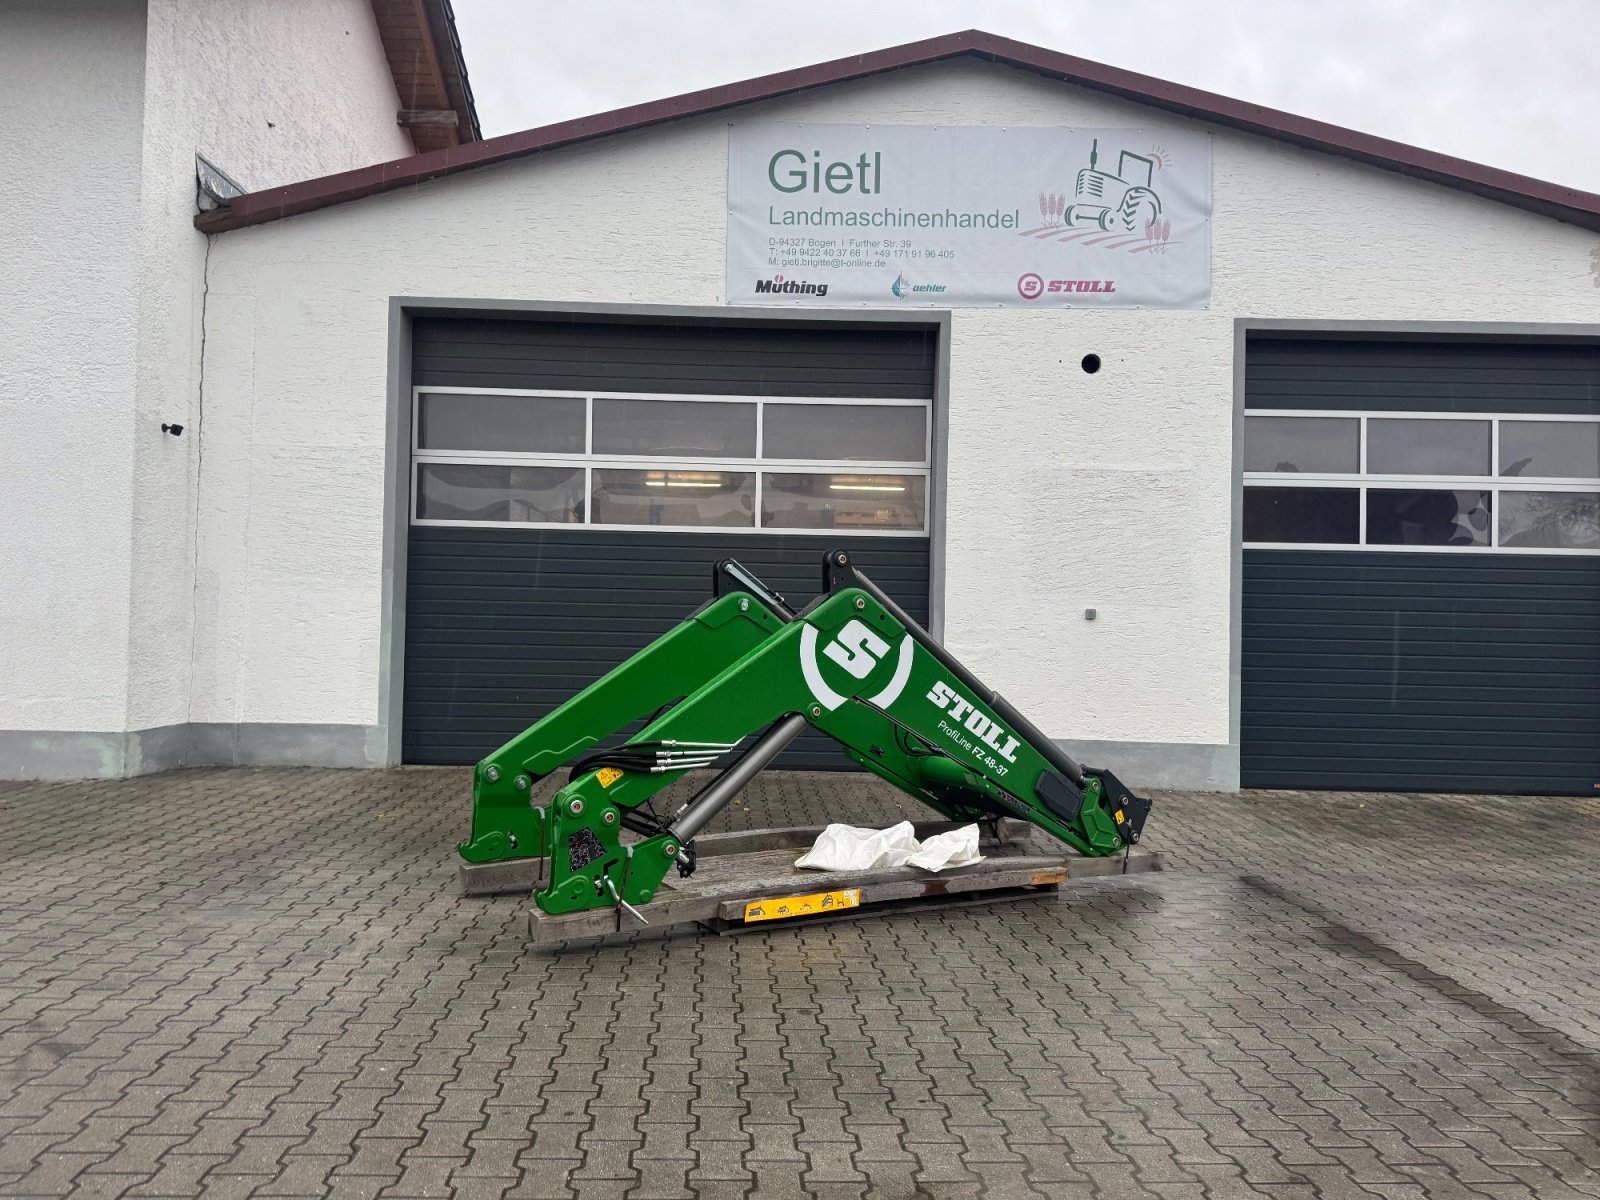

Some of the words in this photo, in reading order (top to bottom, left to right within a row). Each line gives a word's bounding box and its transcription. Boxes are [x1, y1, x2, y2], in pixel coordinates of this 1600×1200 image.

[768, 149, 881, 194] Gietl
[768, 206, 1019, 228] Landmaschinenhandel
[768, 237, 805, 247] D-94327
[808, 238, 836, 248] Bogen
[849, 239, 880, 248] Further
[883, 240, 898, 248] Str.
[900, 240, 912, 248] 39
[768, 247, 778, 256] T:
[780, 248, 797, 256] +49
[799, 248, 821, 257] 9422
[822, 248, 834, 257] 40
[836, 249, 847, 257] 37
[849, 249, 861, 257] 66
[874, 249, 891, 258] +49
[893, 250, 908, 258] 171
[911, 250, 922, 258] 91
[925, 250, 936, 259] 96
[938, 250, 955, 259] 405
[768, 257, 779, 266] M:
[781, 258, 886, 269] gietl.brigitte@t-online.de
[755, 274, 829, 297] Müthing
[1047, 280, 1116, 293] STOLL
[925, 680, 1021, 764] STOLL
[937, 719, 972, 751] ProfiLine
[971, 746, 986, 760] FZ
[983, 756, 1009, 777] 48-37
